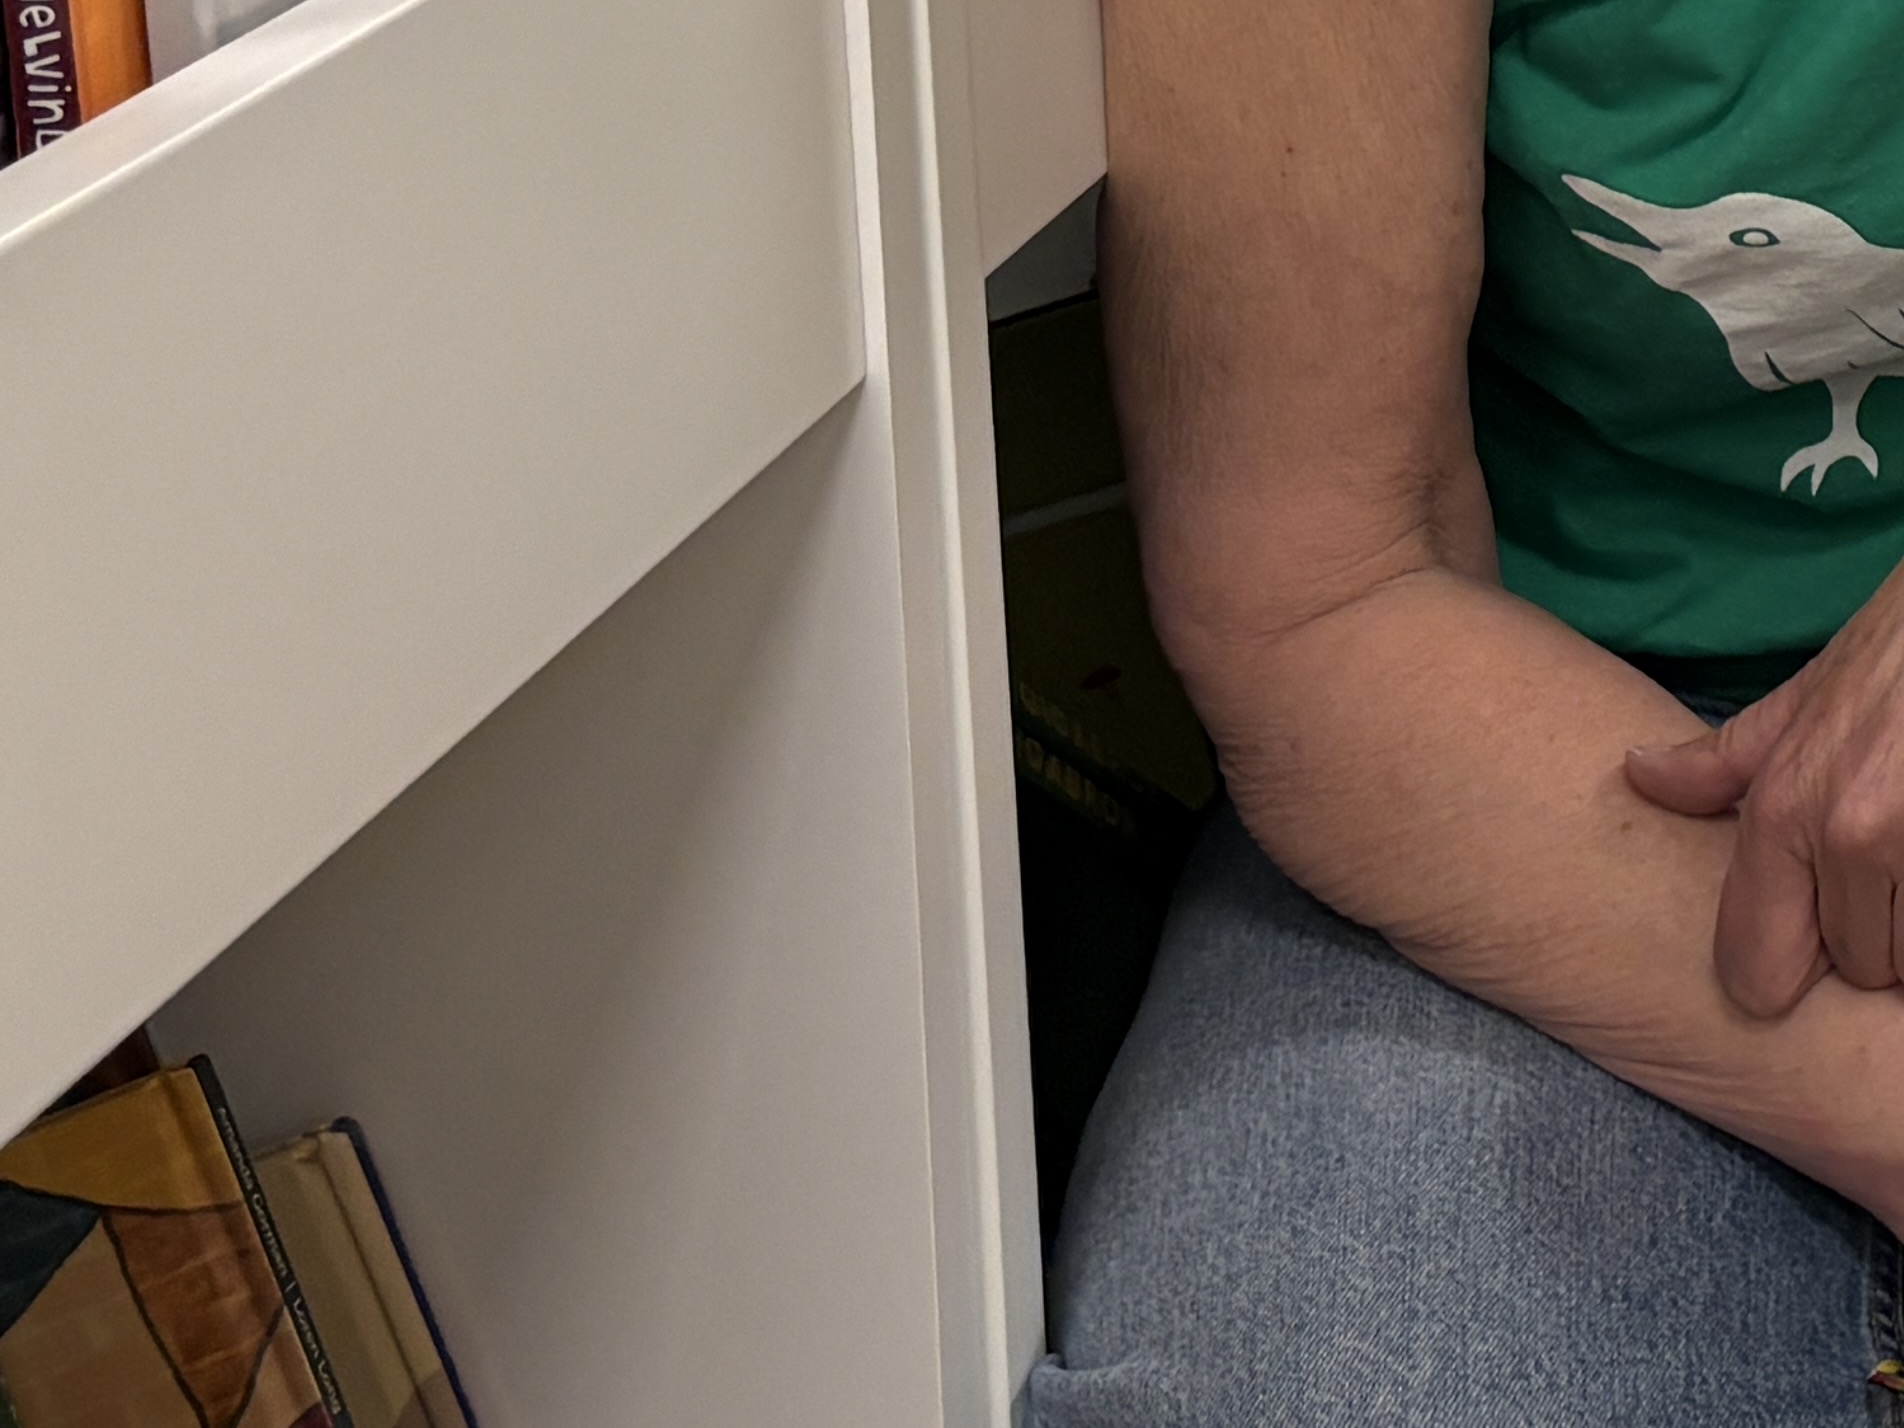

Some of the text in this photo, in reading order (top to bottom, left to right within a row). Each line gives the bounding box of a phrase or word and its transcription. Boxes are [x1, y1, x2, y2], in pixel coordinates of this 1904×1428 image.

[216, 1105, 342, 1416] Amanda Gorman Loren Long
